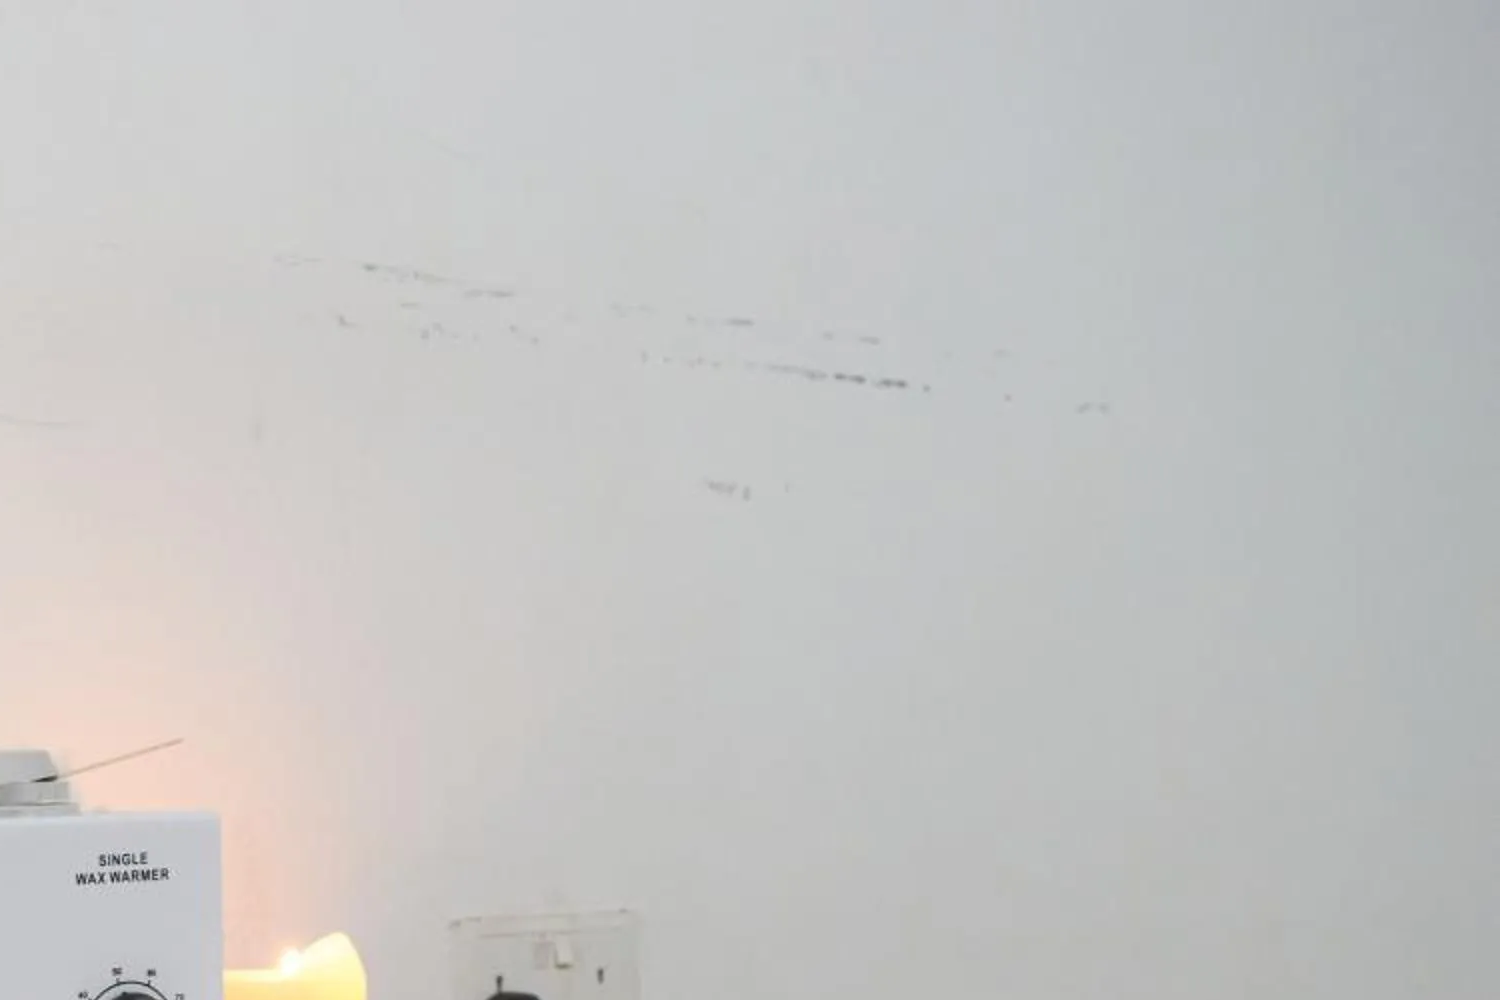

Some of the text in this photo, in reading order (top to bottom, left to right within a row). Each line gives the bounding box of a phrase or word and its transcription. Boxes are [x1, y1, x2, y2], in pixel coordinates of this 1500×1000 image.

[99, 852, 148, 867] SINGLE
[76, 868, 169, 885] WAX WARMER
